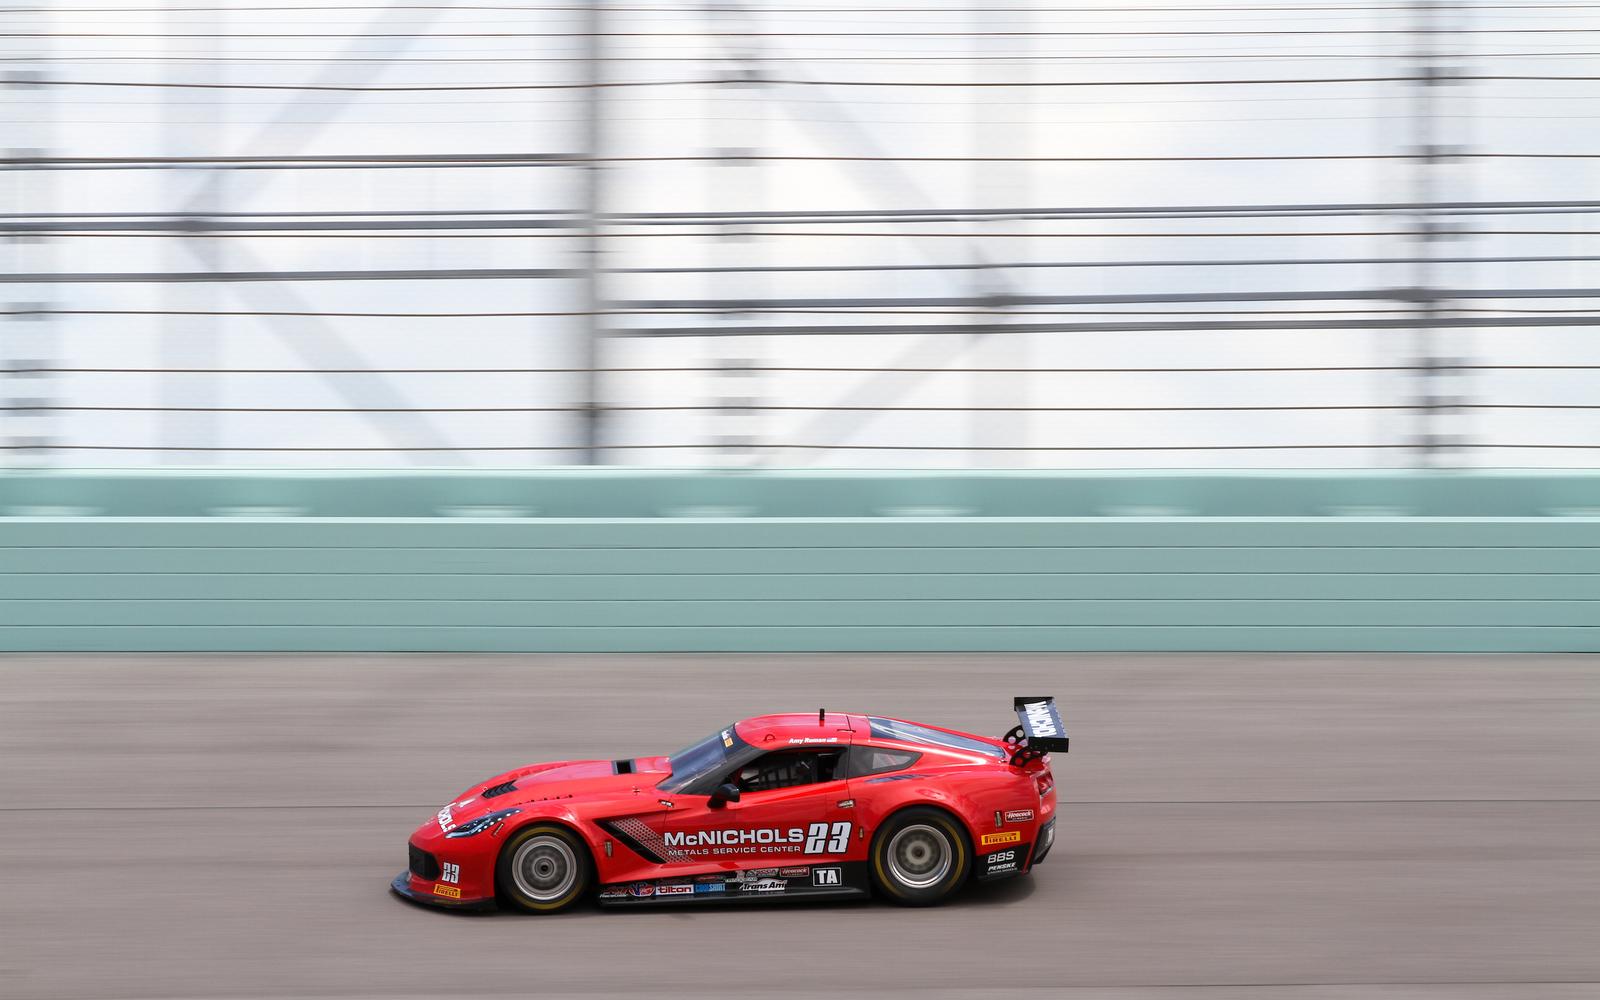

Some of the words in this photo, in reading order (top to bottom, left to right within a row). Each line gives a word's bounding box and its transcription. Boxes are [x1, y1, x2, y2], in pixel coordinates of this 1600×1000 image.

[664, 828, 803, 846] McNICHOLS
[804, 822, 852, 854] 23
[668, 848, 709, 856] METALS
[712, 847, 757, 855] SERVICE
[987, 850, 1015, 864] BBS
[441, 862, 460, 884] 23
[988, 862, 1016, 871] PENSKE
[816, 869, 838, 884] TA
[659, 885, 692, 894] tilton
[742, 882, 768, 890] Trans
[768, 881, 785, 889] Am
